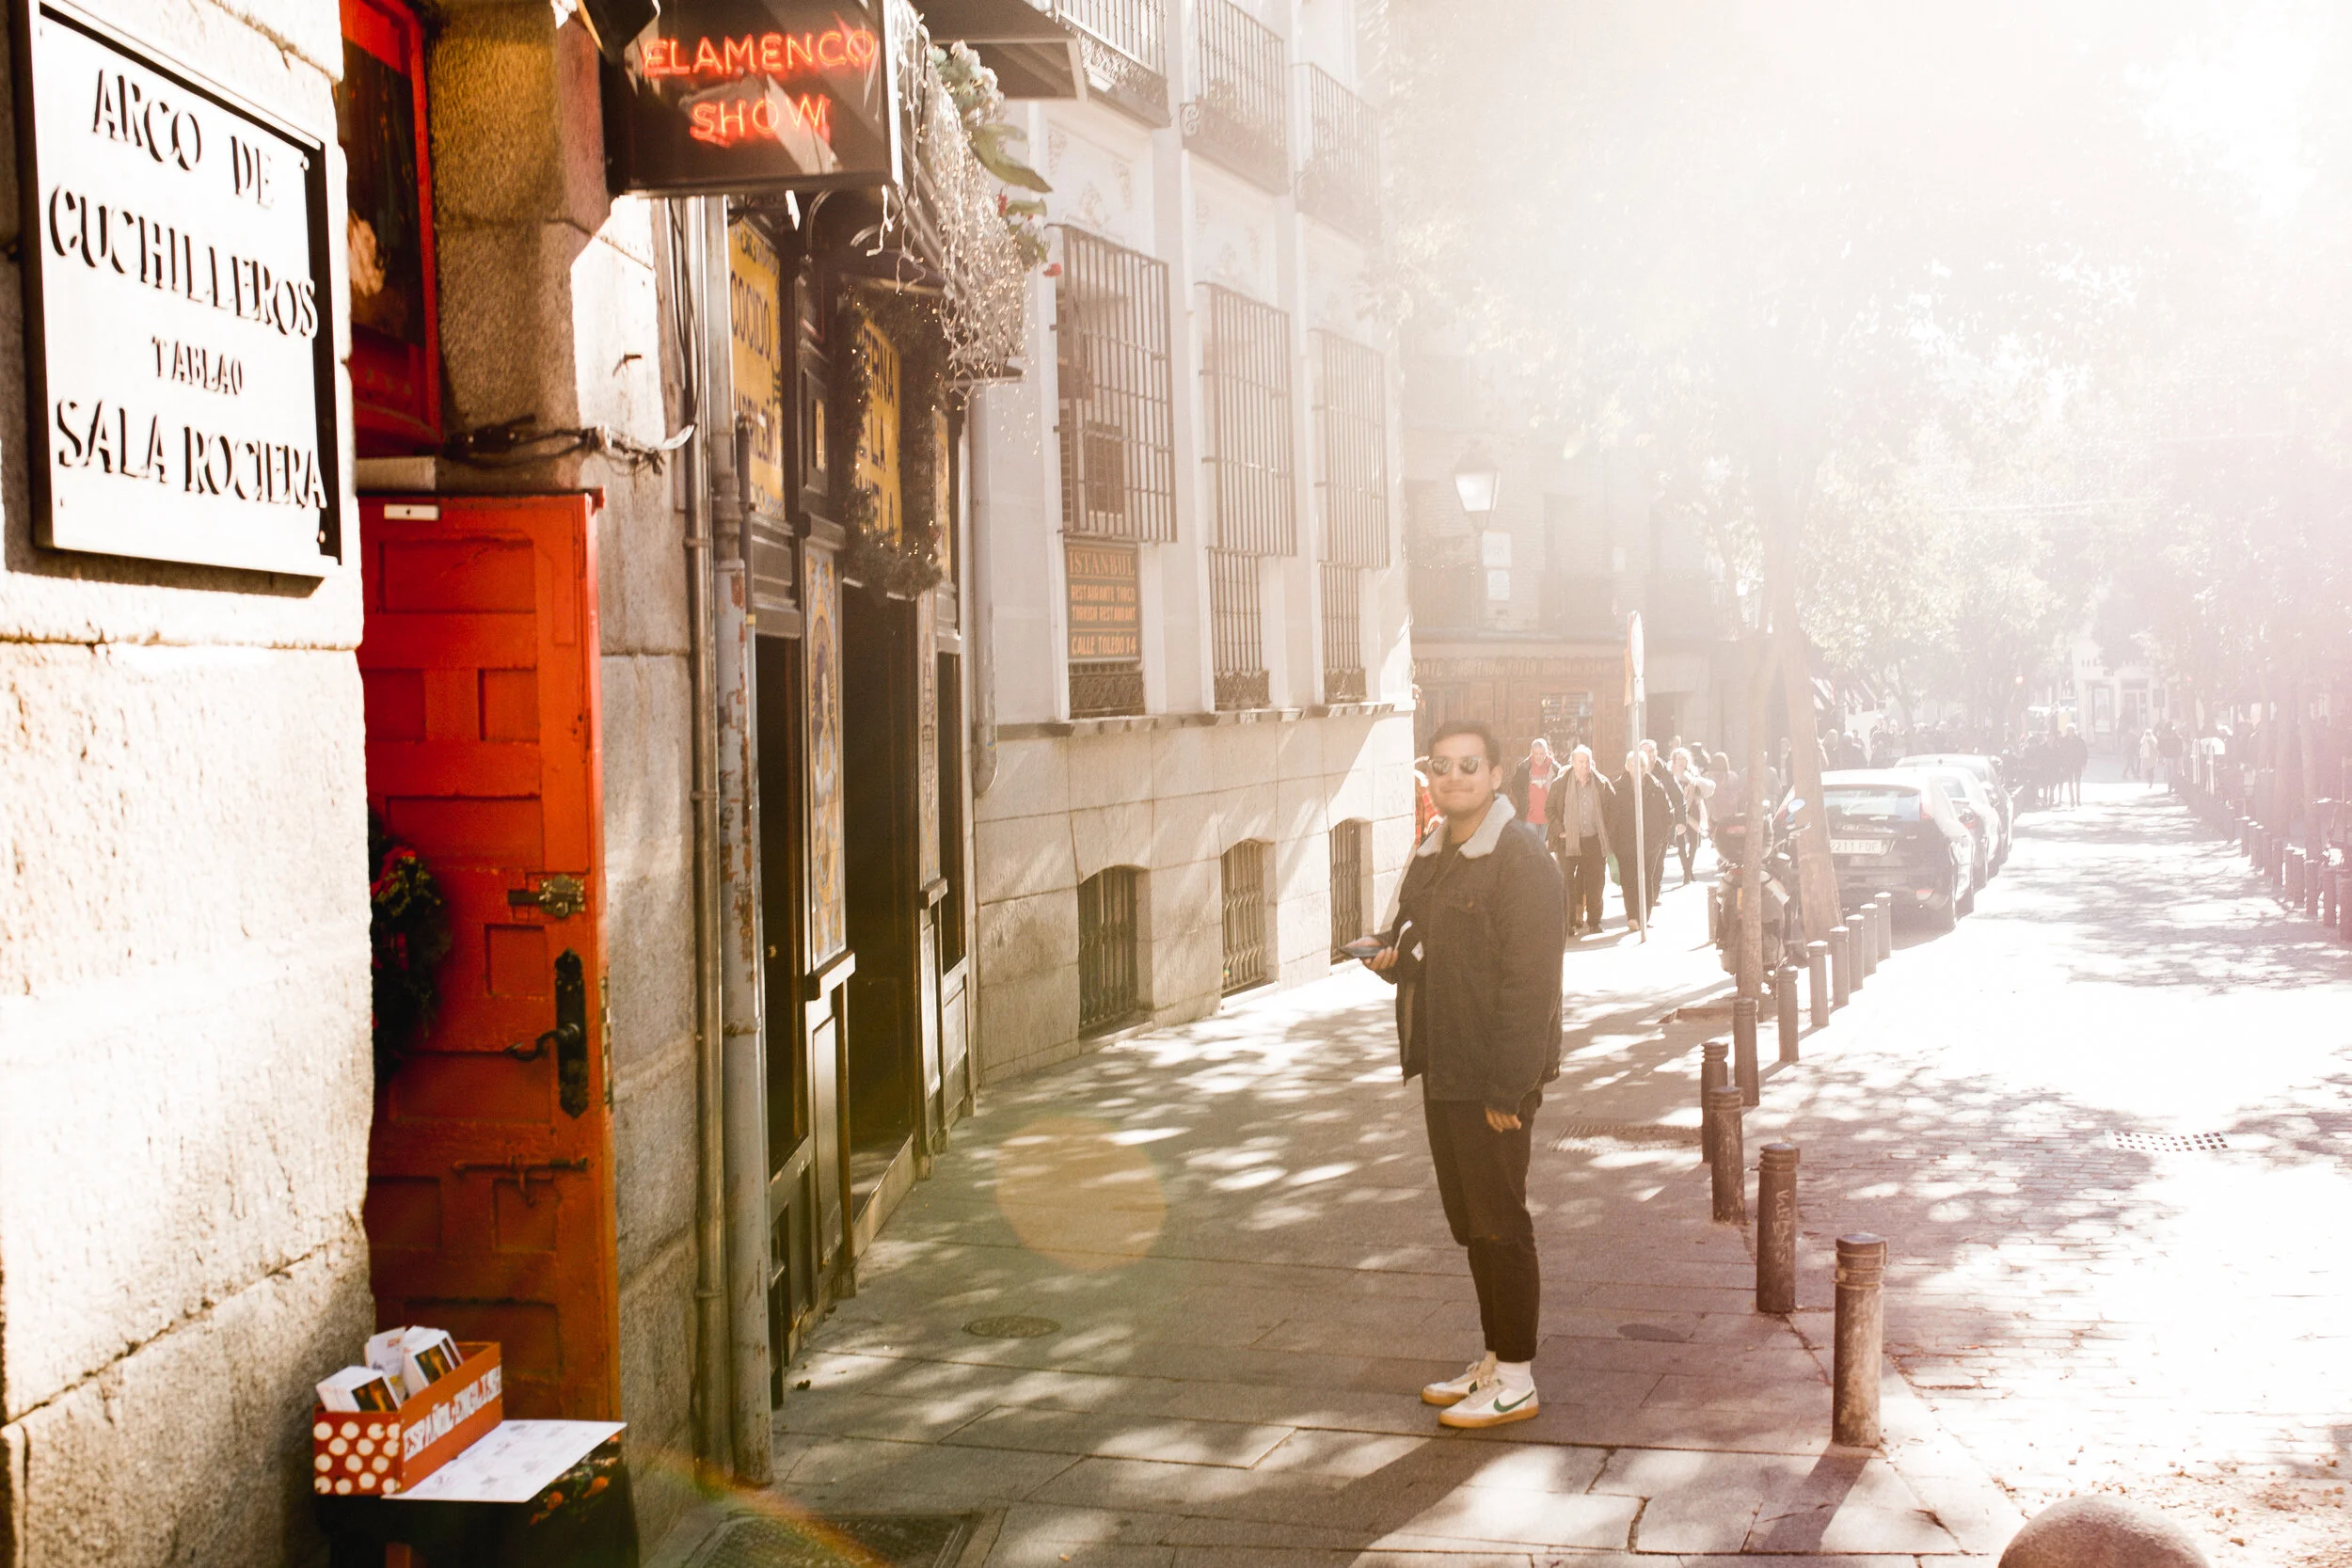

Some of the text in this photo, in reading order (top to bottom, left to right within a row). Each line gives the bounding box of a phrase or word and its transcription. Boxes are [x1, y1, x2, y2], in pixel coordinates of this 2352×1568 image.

[93, 69, 275, 209] ARCO DE
[691, 94, 832, 143] SHOW
[48, 185, 319, 339] CUCHILLEROS
[731, 269, 771, 362] COCIDO
[151, 334, 244, 396] TABLAO
[56, 399, 326, 510] SALA ROCIERA
[1069, 551, 1136, 577] ISTANBUL
[1071, 584, 1115, 603] RESTAURANTE
[1072, 635, 1136, 656] CALLE TOLEDO 14
